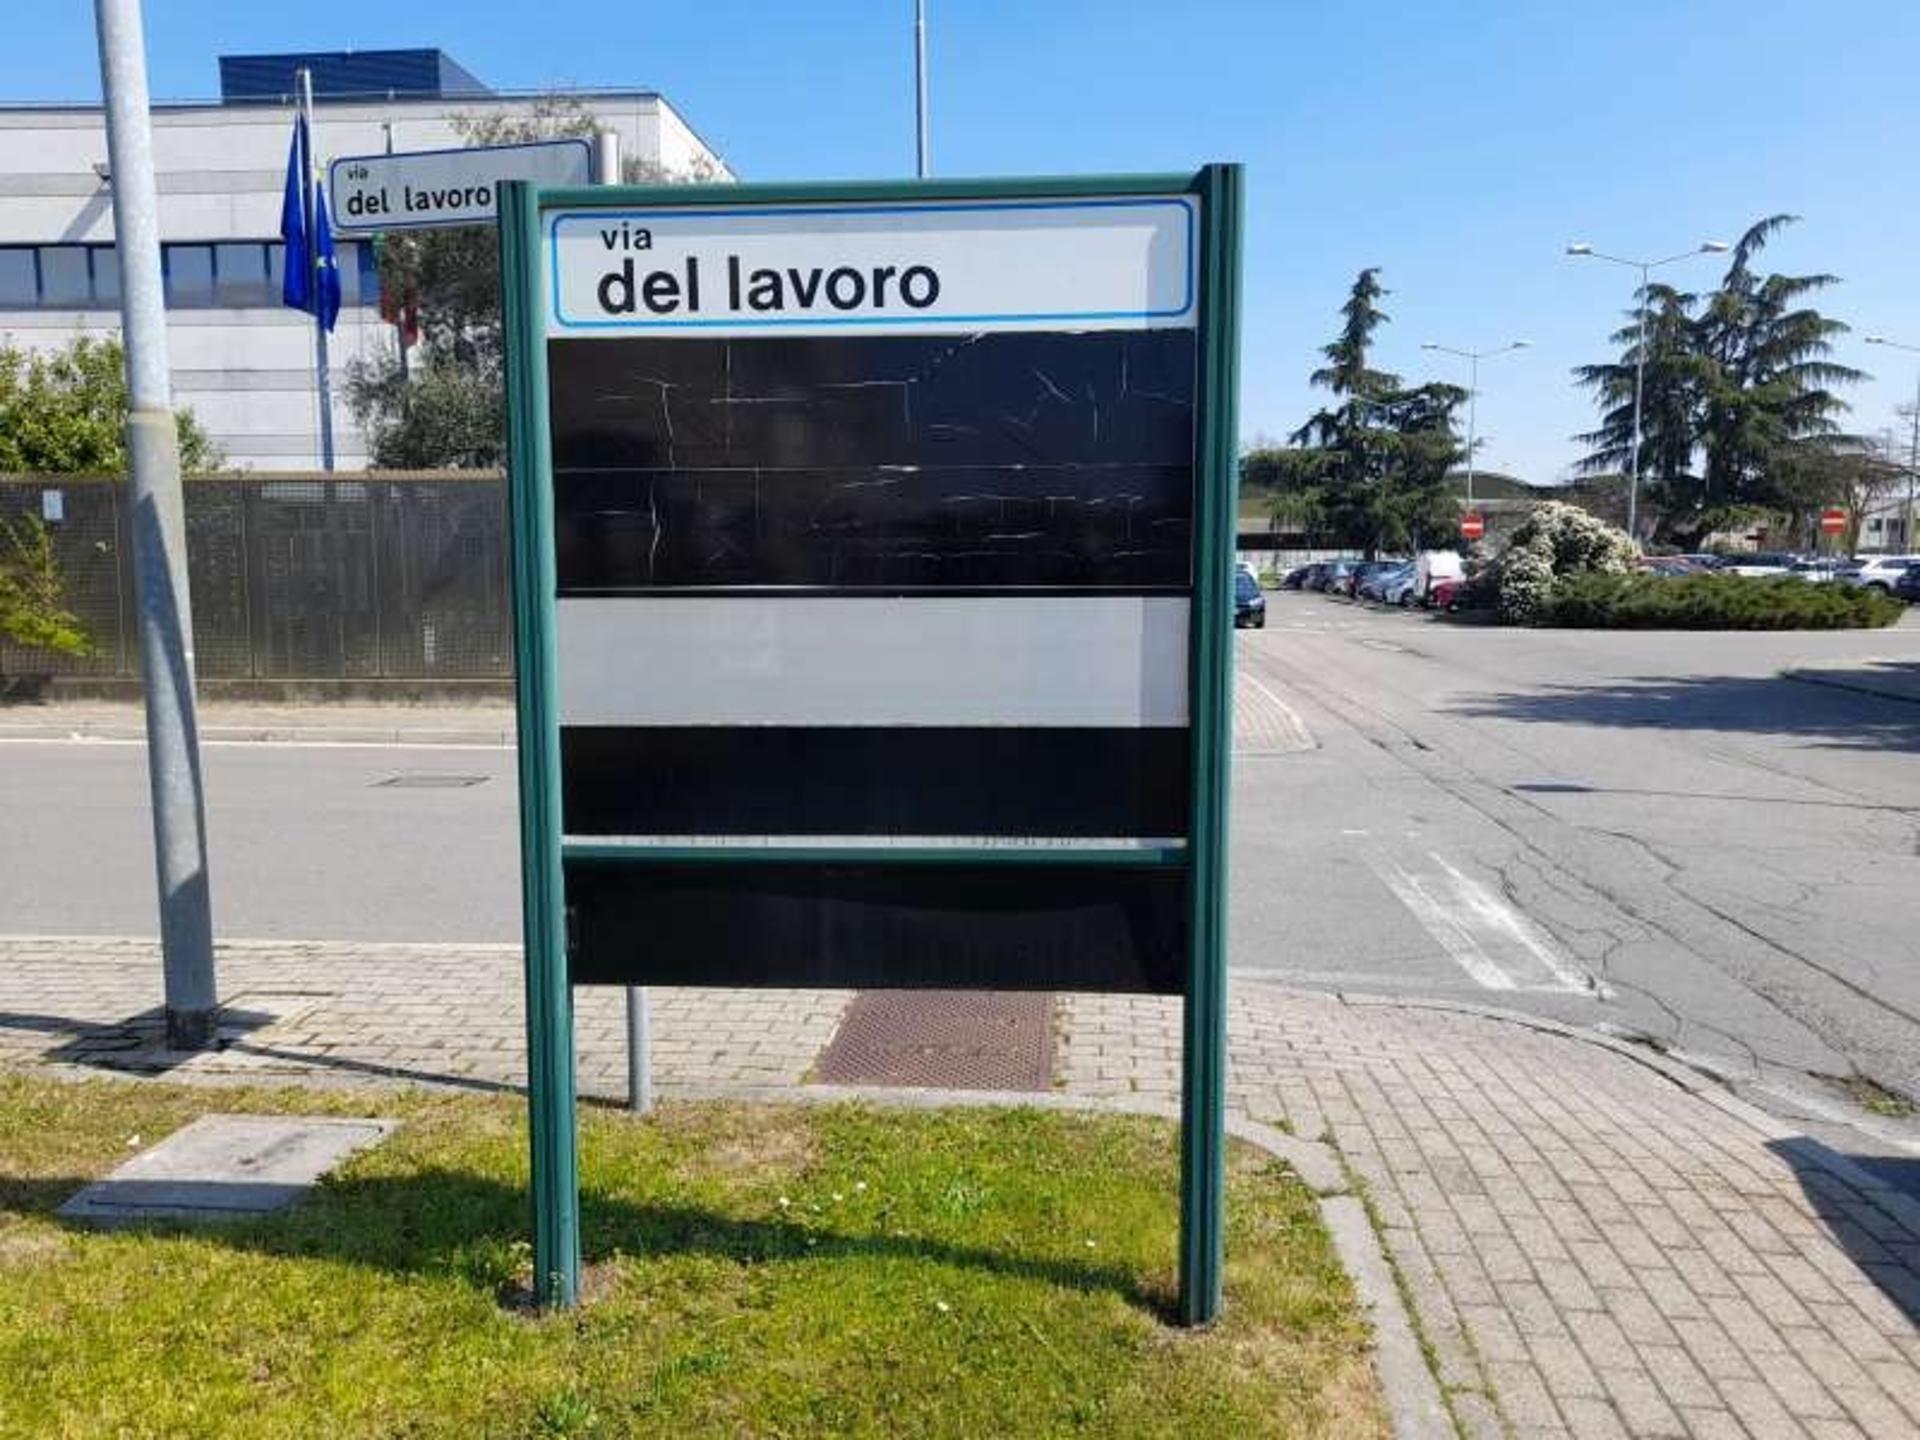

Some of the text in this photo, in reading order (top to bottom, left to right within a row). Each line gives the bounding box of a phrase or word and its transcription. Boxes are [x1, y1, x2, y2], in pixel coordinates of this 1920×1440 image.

[348, 164, 369, 180] via
[347, 185, 491, 215] del lavoro
[600, 221, 653, 250] via
[597, 255, 940, 314] del lavoro
